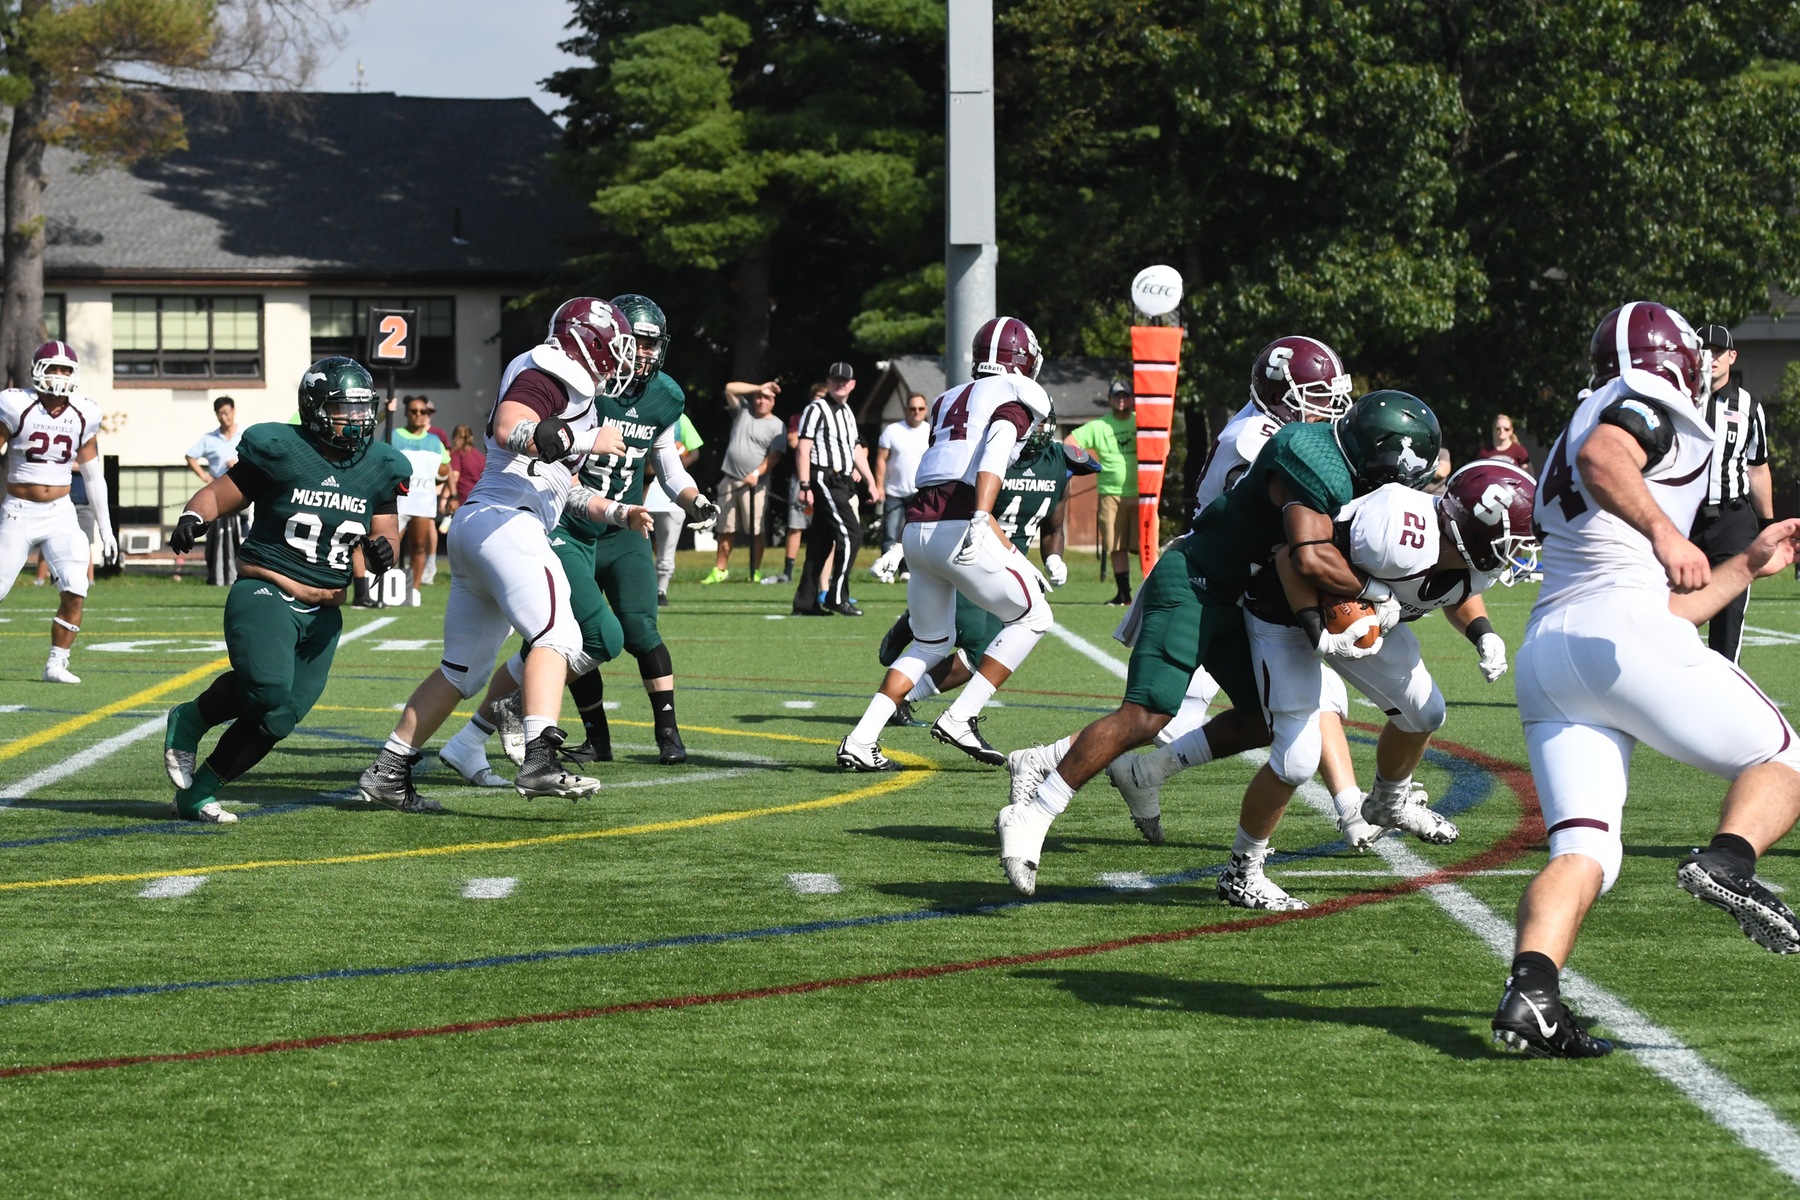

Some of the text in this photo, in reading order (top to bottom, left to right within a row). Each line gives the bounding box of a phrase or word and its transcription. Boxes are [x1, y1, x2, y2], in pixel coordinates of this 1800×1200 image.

[1142, 283, 1176, 297] ECFC
[589, 300, 613, 328] S
[378, 315, 408, 358] 2
[1265, 346, 1294, 381] S
[33, 423, 73, 433] SPRINGFIELD
[1727, 430, 1737, 443] U
[26, 431, 73, 464] 23
[290, 488, 367, 514] MUSTANGS
[1001, 479, 1056, 492] MUSTANGS
[998, 495, 1052, 546] 44
[1473, 483, 1513, 526] S
[284, 512, 366, 570] 98
[1399, 511, 1426, 549] 22
